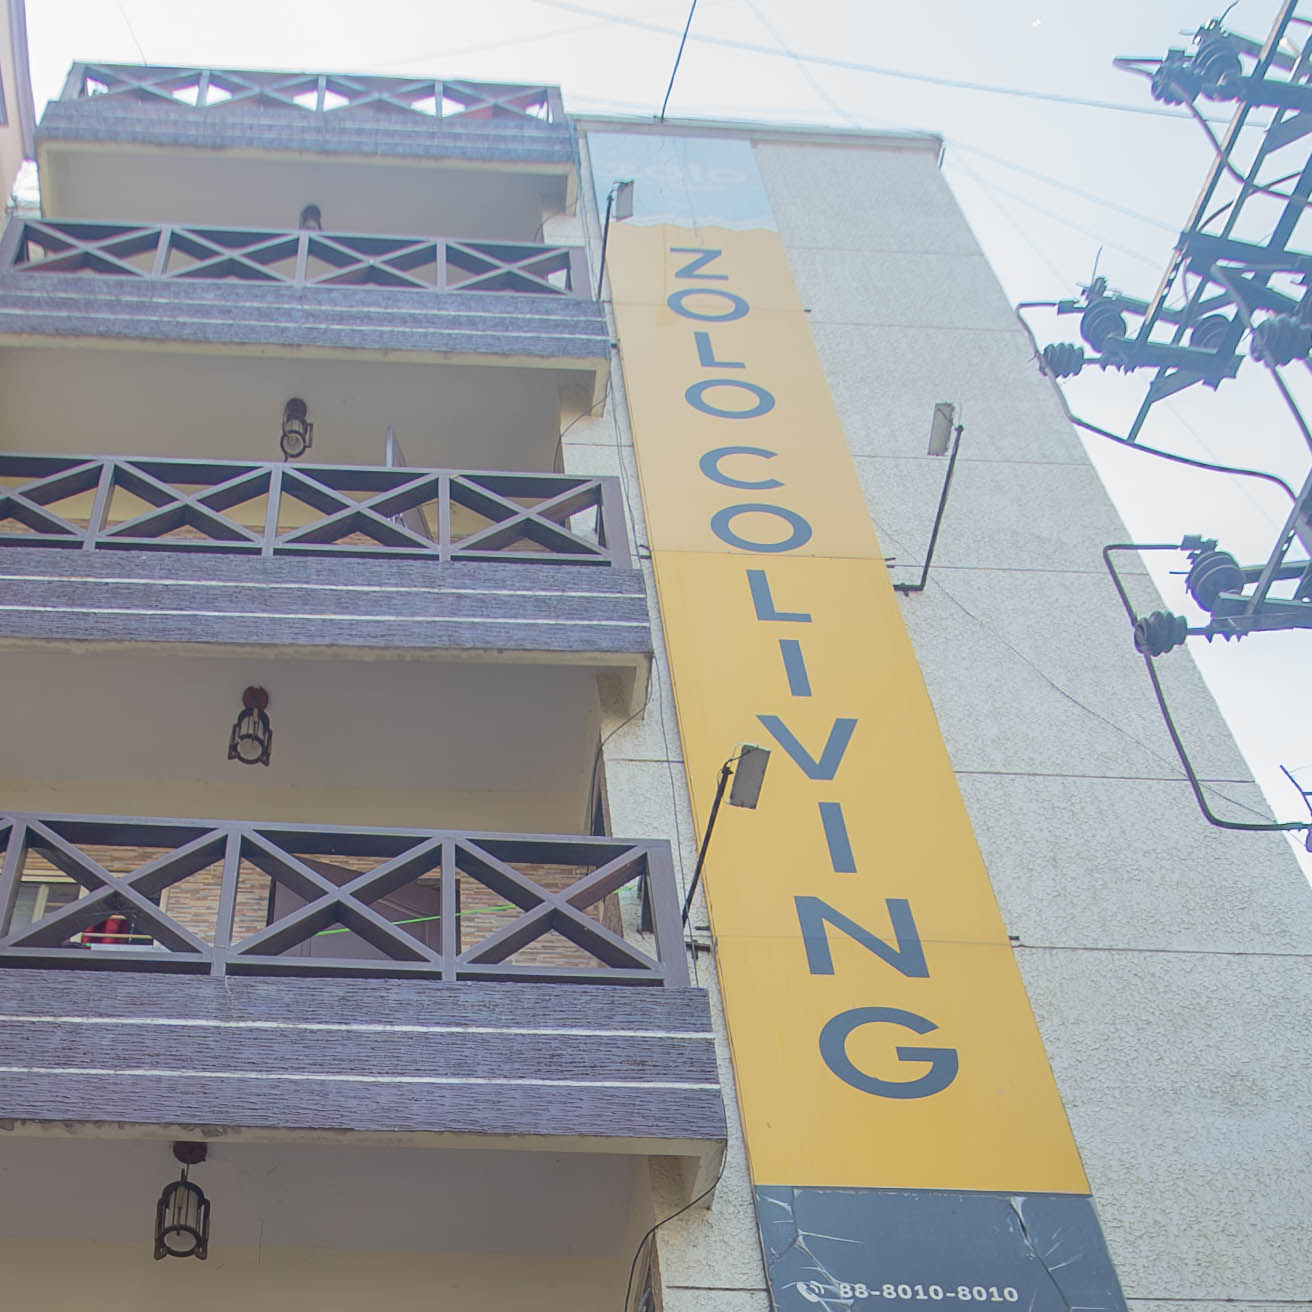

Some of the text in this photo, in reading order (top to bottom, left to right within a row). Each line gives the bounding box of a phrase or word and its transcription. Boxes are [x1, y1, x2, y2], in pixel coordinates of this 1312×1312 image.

[667, 247, 960, 1100] ZOLO COLIVING
[839, 1283, 1019, 1302] 88-8010-8010
